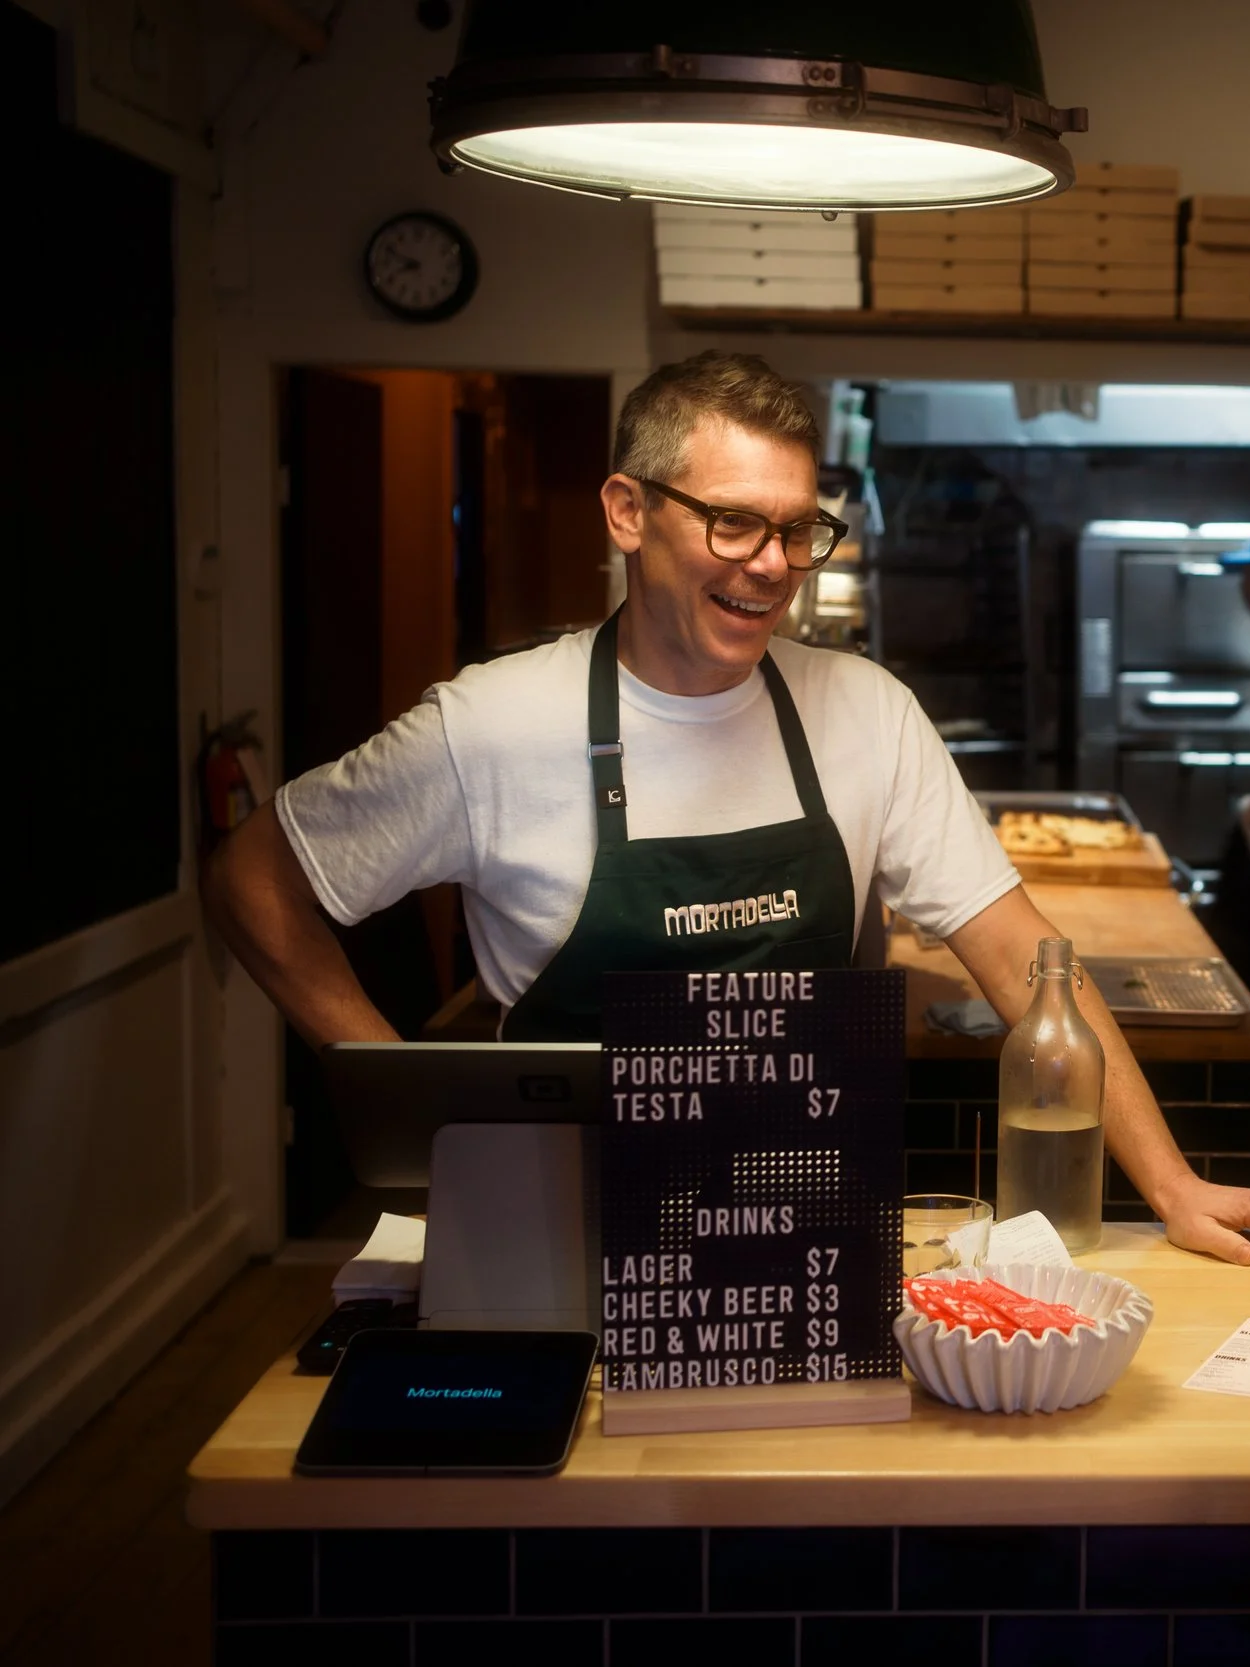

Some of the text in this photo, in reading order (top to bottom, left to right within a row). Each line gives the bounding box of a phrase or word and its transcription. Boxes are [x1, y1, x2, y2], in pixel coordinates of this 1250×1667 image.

[664, 889, 800, 936] MORTADELLA
[687, 971, 814, 1003] FEATURE
[706, 1008, 787, 1039] SLICE
[612, 1053, 815, 1086] PORCHETTA DI
[613, 1086, 841, 1122] TESTA $7
[696, 1205, 795, 1237] DRINKS
[603, 1247, 840, 1286] LAGER $7
[603, 1282, 840, 1321] CHEEKY BEER $3
[603, 1317, 840, 1357] RED & WHITE $9
[603, 1352, 849, 1393] LAMBRUSCO $15
[406, 1387, 503, 1399] Mortadella
